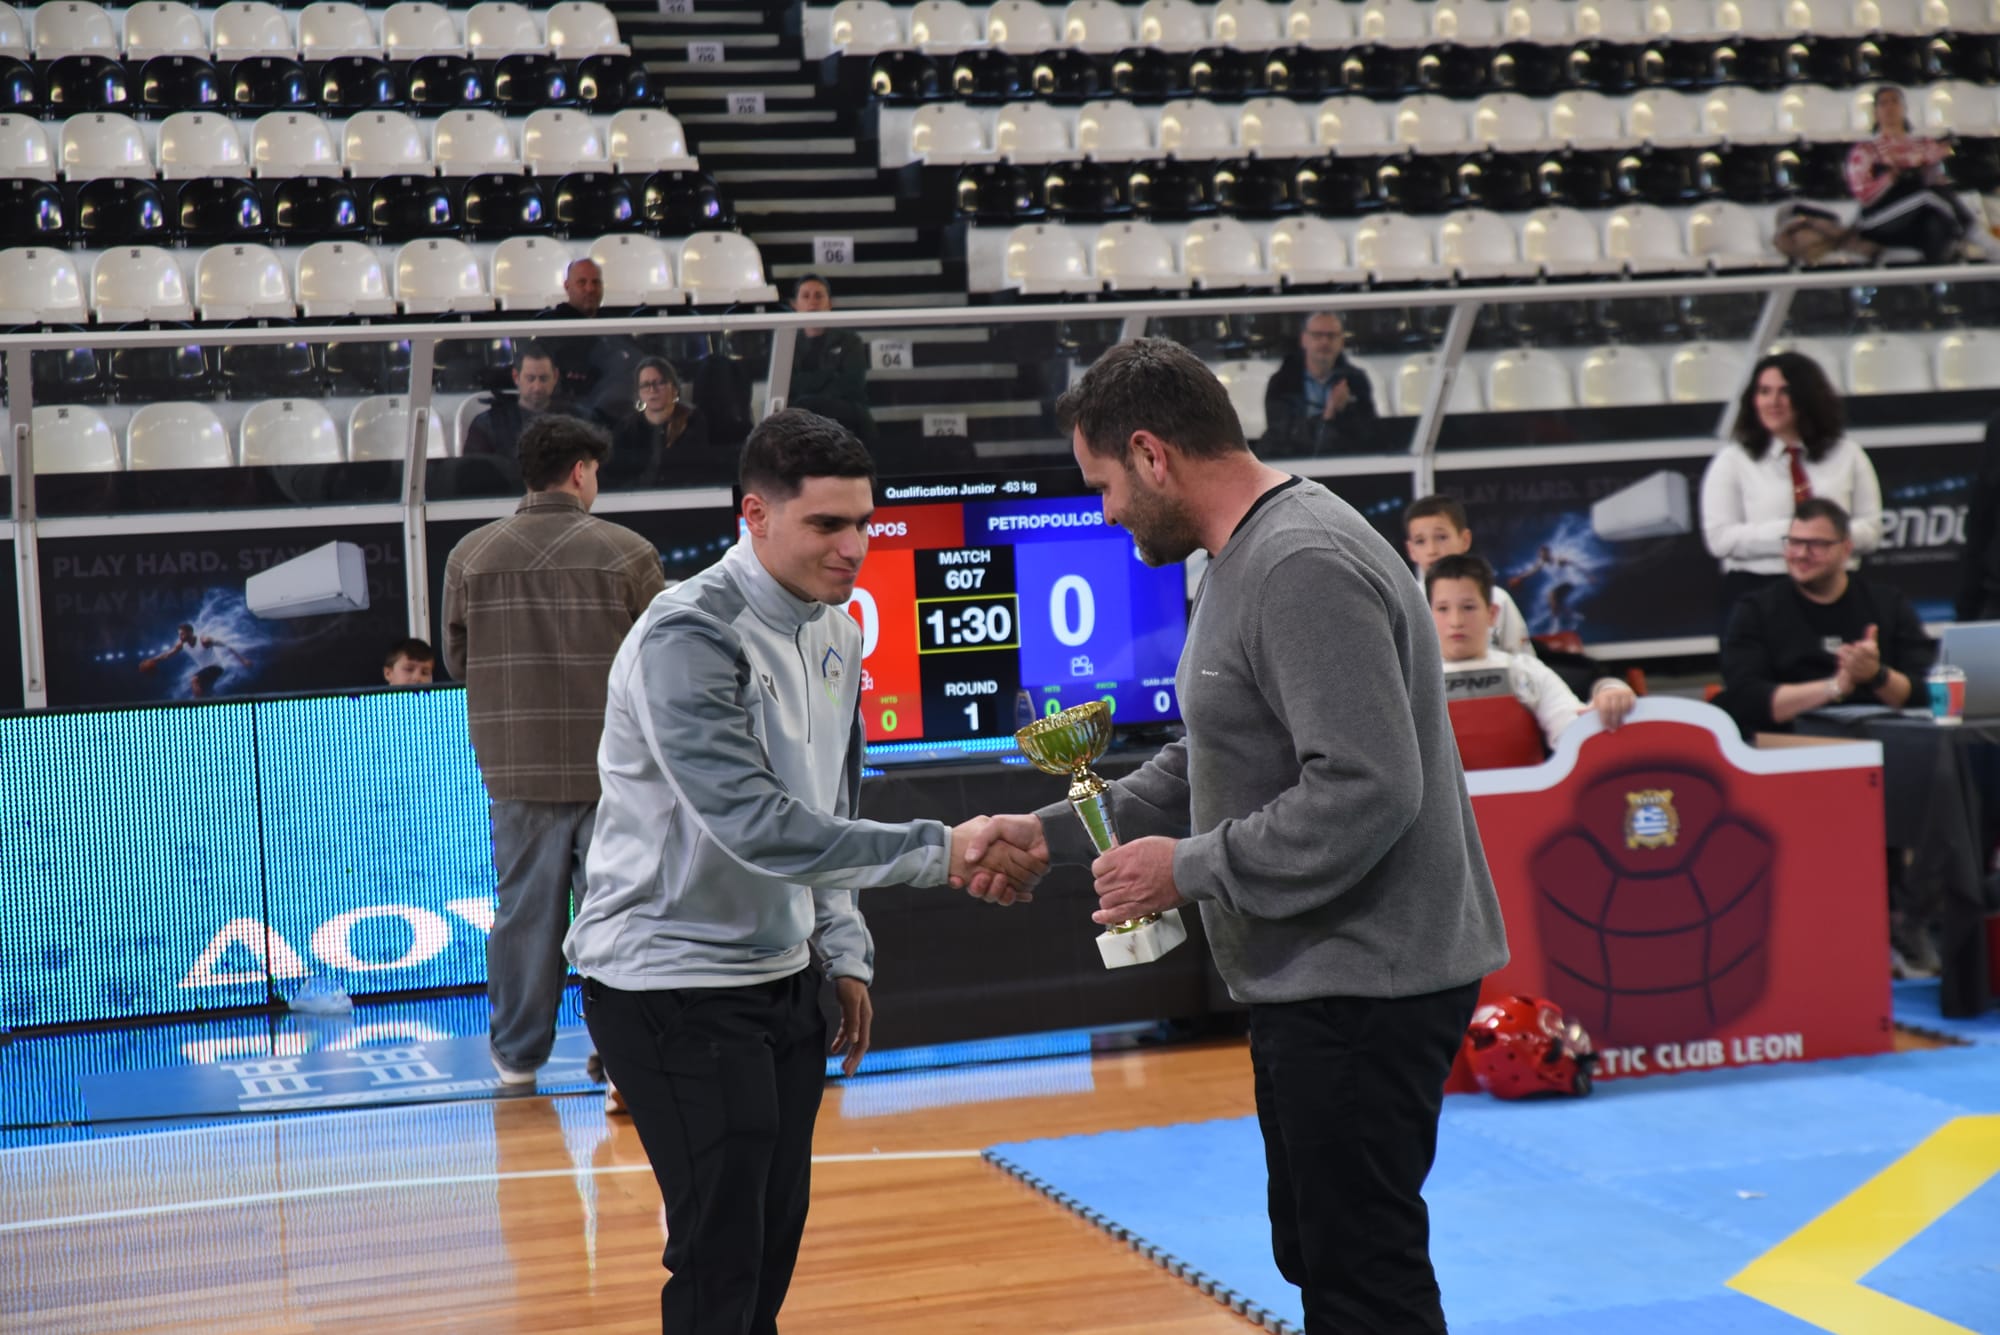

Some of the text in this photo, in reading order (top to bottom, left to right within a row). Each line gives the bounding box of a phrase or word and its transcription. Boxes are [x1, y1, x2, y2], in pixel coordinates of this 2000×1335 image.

[825, 248, 845, 263] 06
[882, 352, 902, 368] 04
[885, 484, 958, 499] Qualification
[960, 483, 997, 496] Junior
[1021, 481, 1038, 494] kg
[866, 511, 1103, 538] APOS PETROPOULOS
[52, 553, 126, 579] PLAY
[135, 549, 229, 576] HARD.
[938, 549, 991, 565] MATCH
[945, 569, 986, 590] 607
[1050, 574, 1096, 647] 0
[926, 604, 1012, 645] 1:30
[944, 680, 998, 697] ROUND
[1445, 675, 1502, 693] PNP
[1154, 690, 1171, 713] 0
[881, 709, 898, 732] 0
[963, 701, 980, 731] 1
[1594, 1033, 1804, 1075] TIC CLUB LEON
